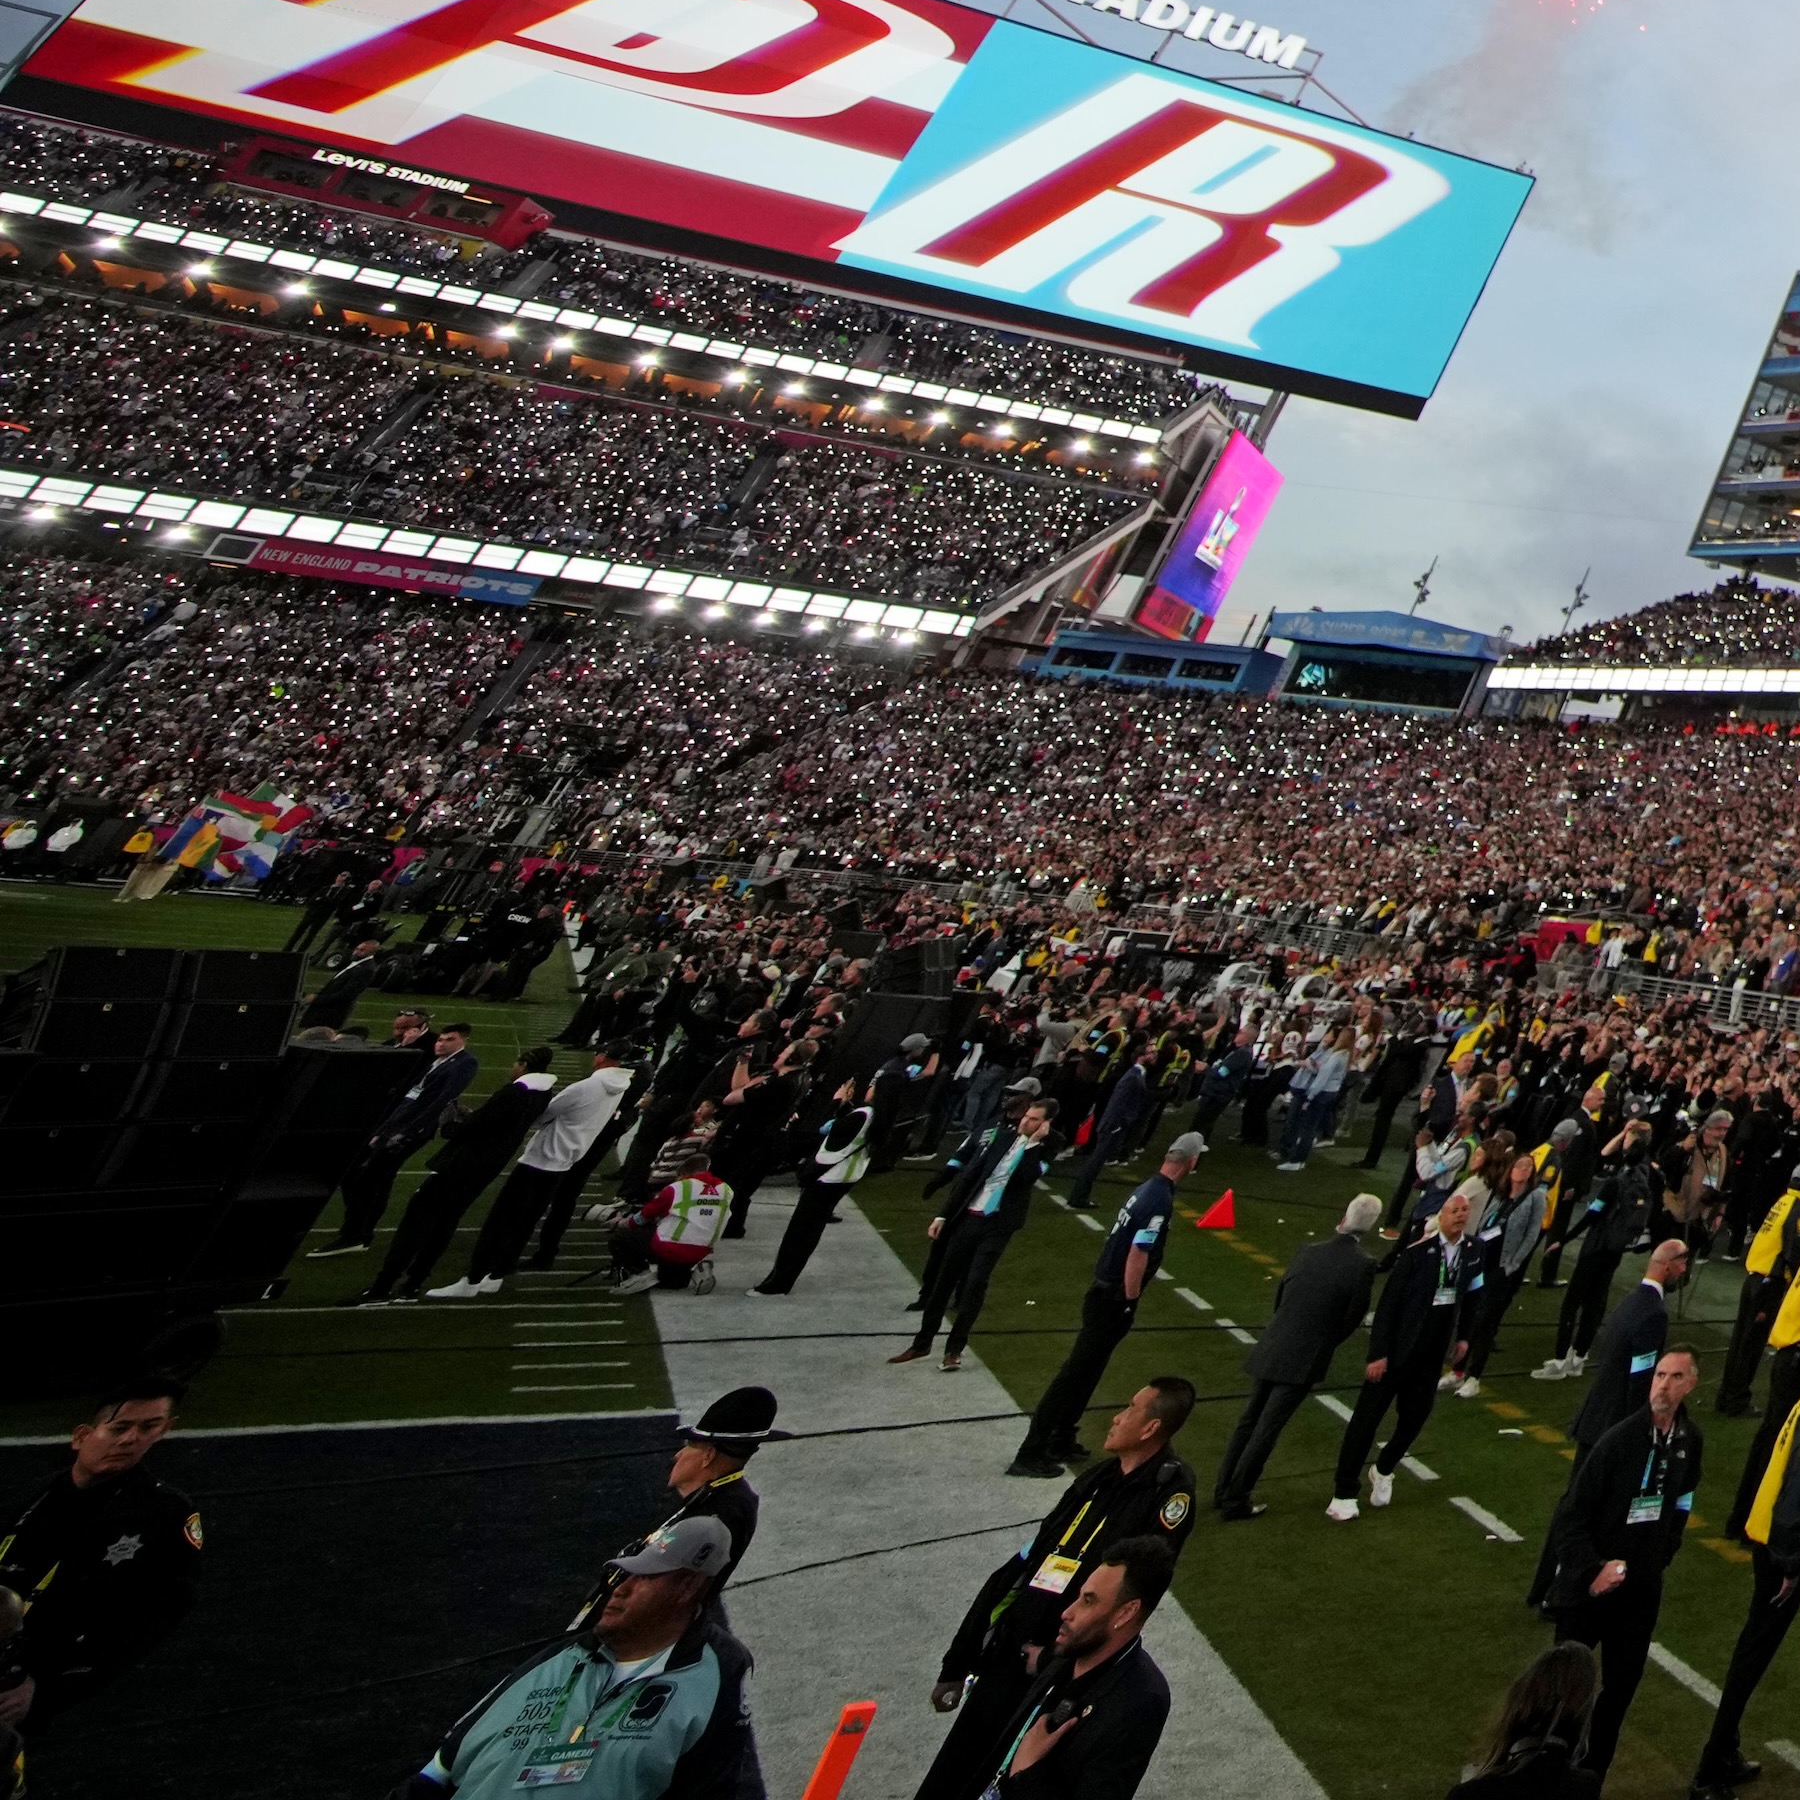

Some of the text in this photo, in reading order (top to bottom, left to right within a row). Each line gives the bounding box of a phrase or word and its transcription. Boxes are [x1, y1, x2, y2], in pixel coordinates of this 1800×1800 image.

[386, 164, 471, 195] STADIUM
[257, 547, 535, 597] NEW ENGLAND PATRIOTS
[507, 913, 533, 924] CREW
[526, 1686, 565, 1701] SECURI
[517, 1700, 556, 1722] 505
[503, 1722, 550, 1738] STAFF
[606, 1733, 652, 1742] Supervisor
[510, 1737, 530, 1751] 99
